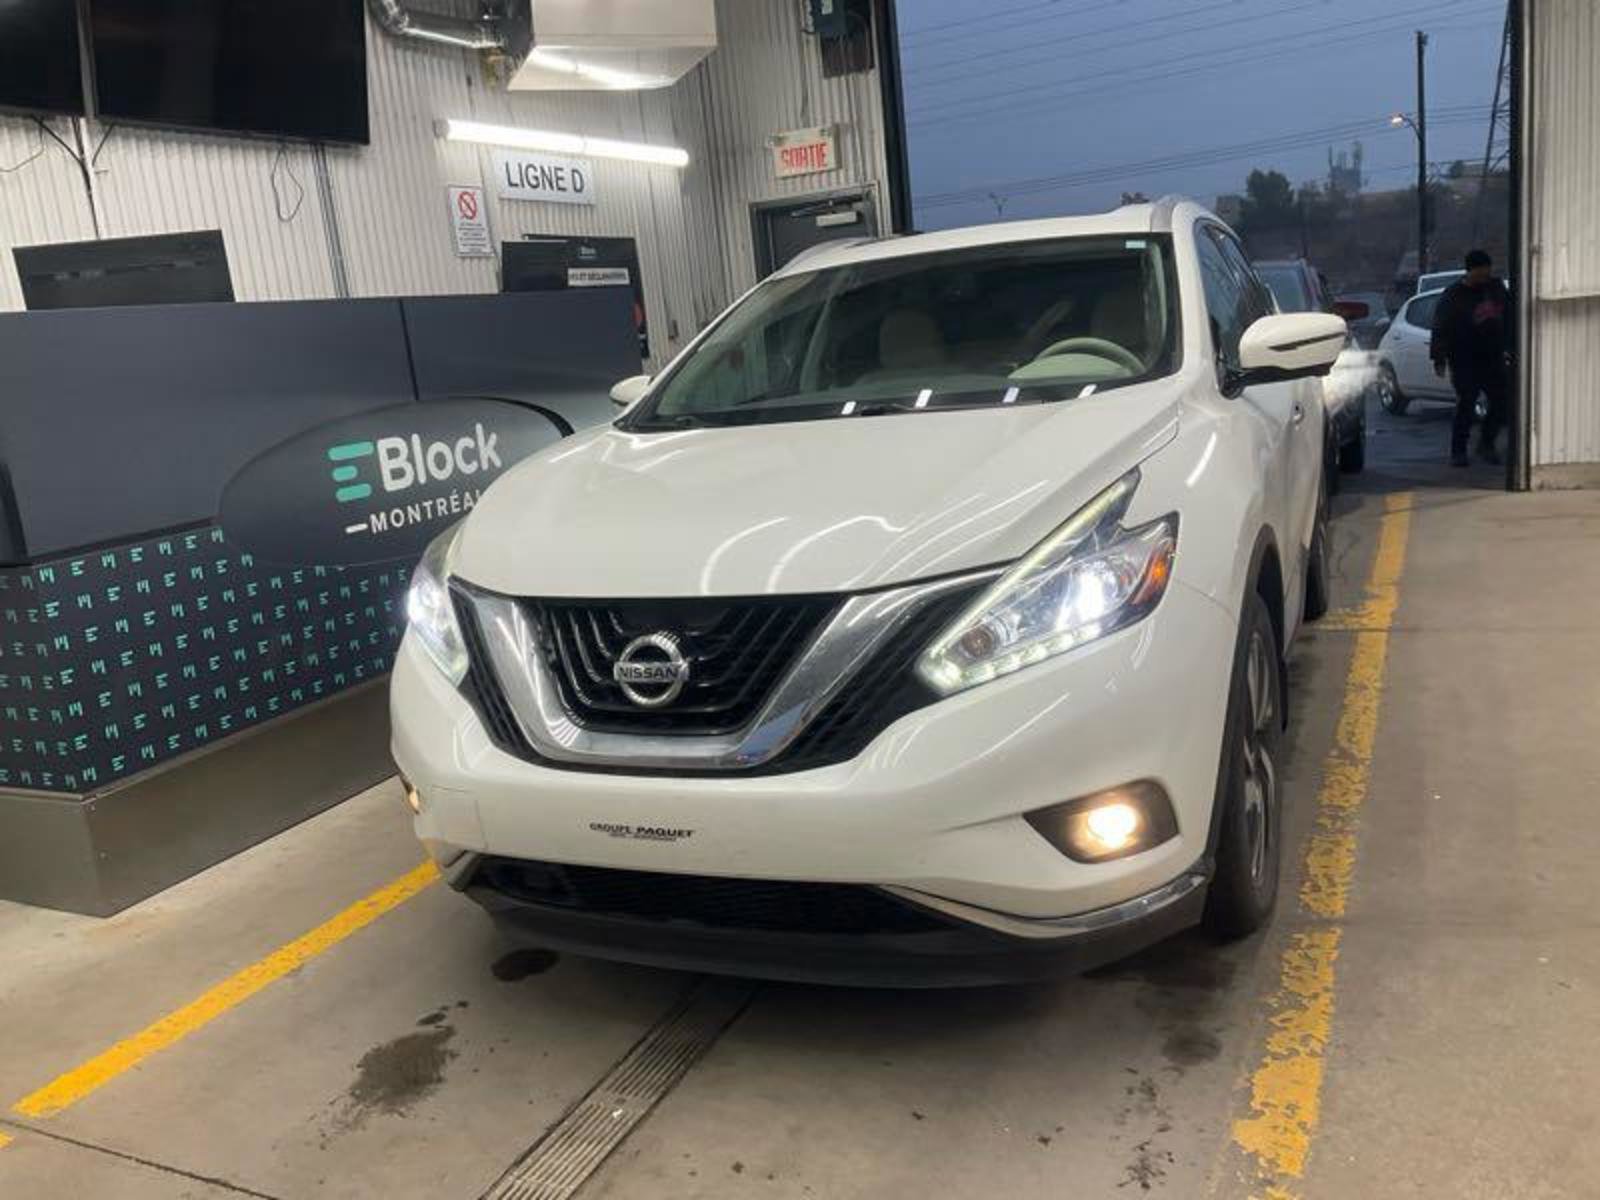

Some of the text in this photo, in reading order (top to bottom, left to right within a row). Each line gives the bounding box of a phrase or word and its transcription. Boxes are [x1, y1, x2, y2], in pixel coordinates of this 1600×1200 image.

[780, 142, 828, 171] SORTIE
[505, 161, 585, 193] LIGNE D
[369, 489, 480, 534] MONTRÉA
[620, 666, 680, 680] NISSAN
[636, 826, 696, 838] PAQUET
